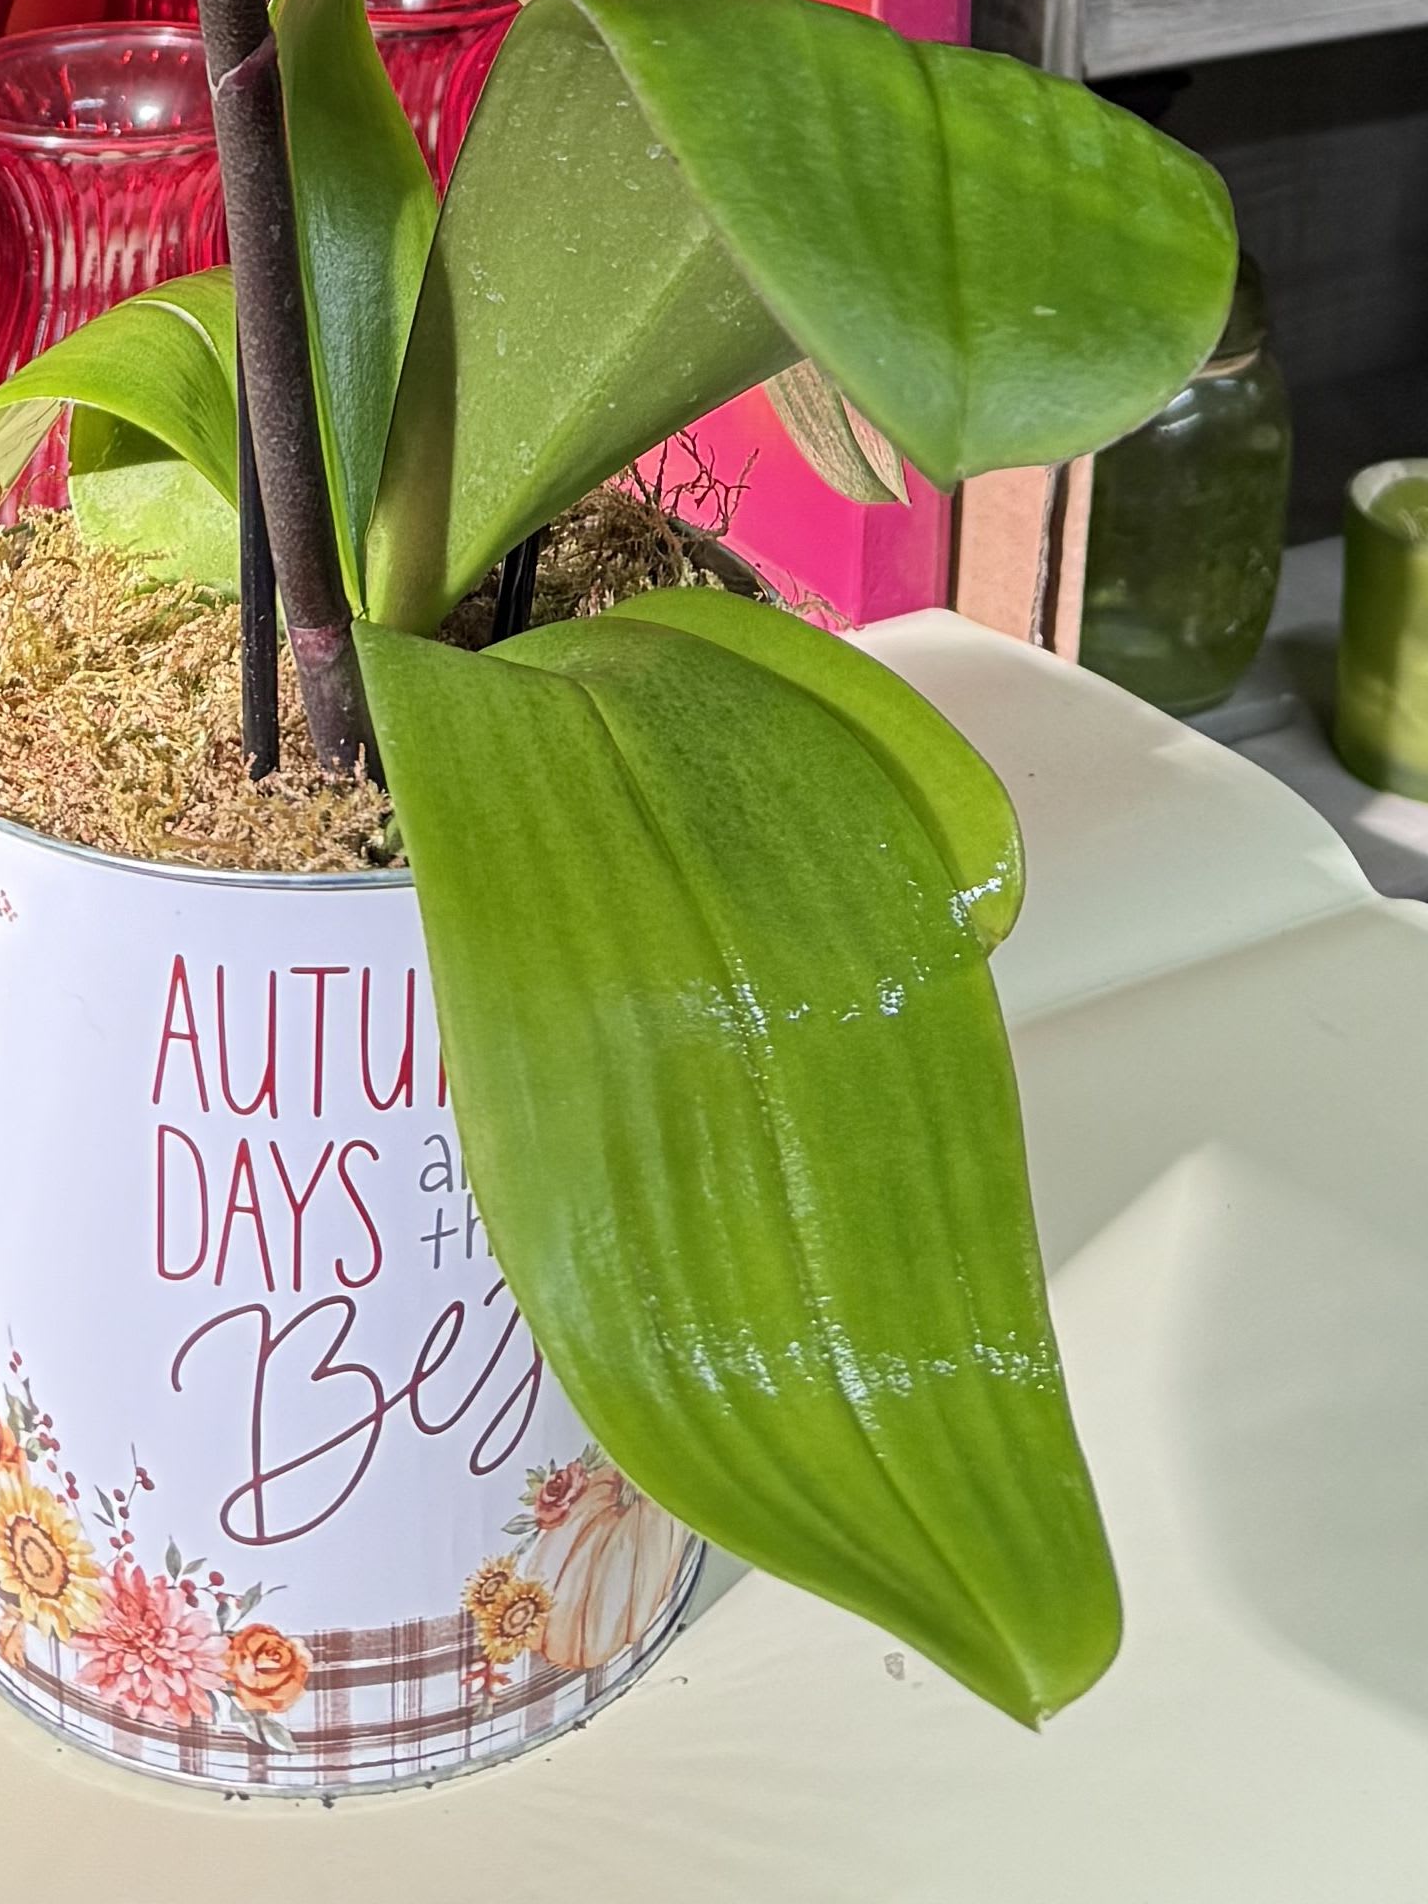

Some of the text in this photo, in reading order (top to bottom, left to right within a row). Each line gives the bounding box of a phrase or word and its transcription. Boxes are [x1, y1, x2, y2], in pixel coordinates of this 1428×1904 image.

[152, 953, 448, 1119] AUTU
[157, 1124, 383, 1293] DAYS
[420, 1193, 494, 1270] th
[171, 1278, 544, 1547] Bes
